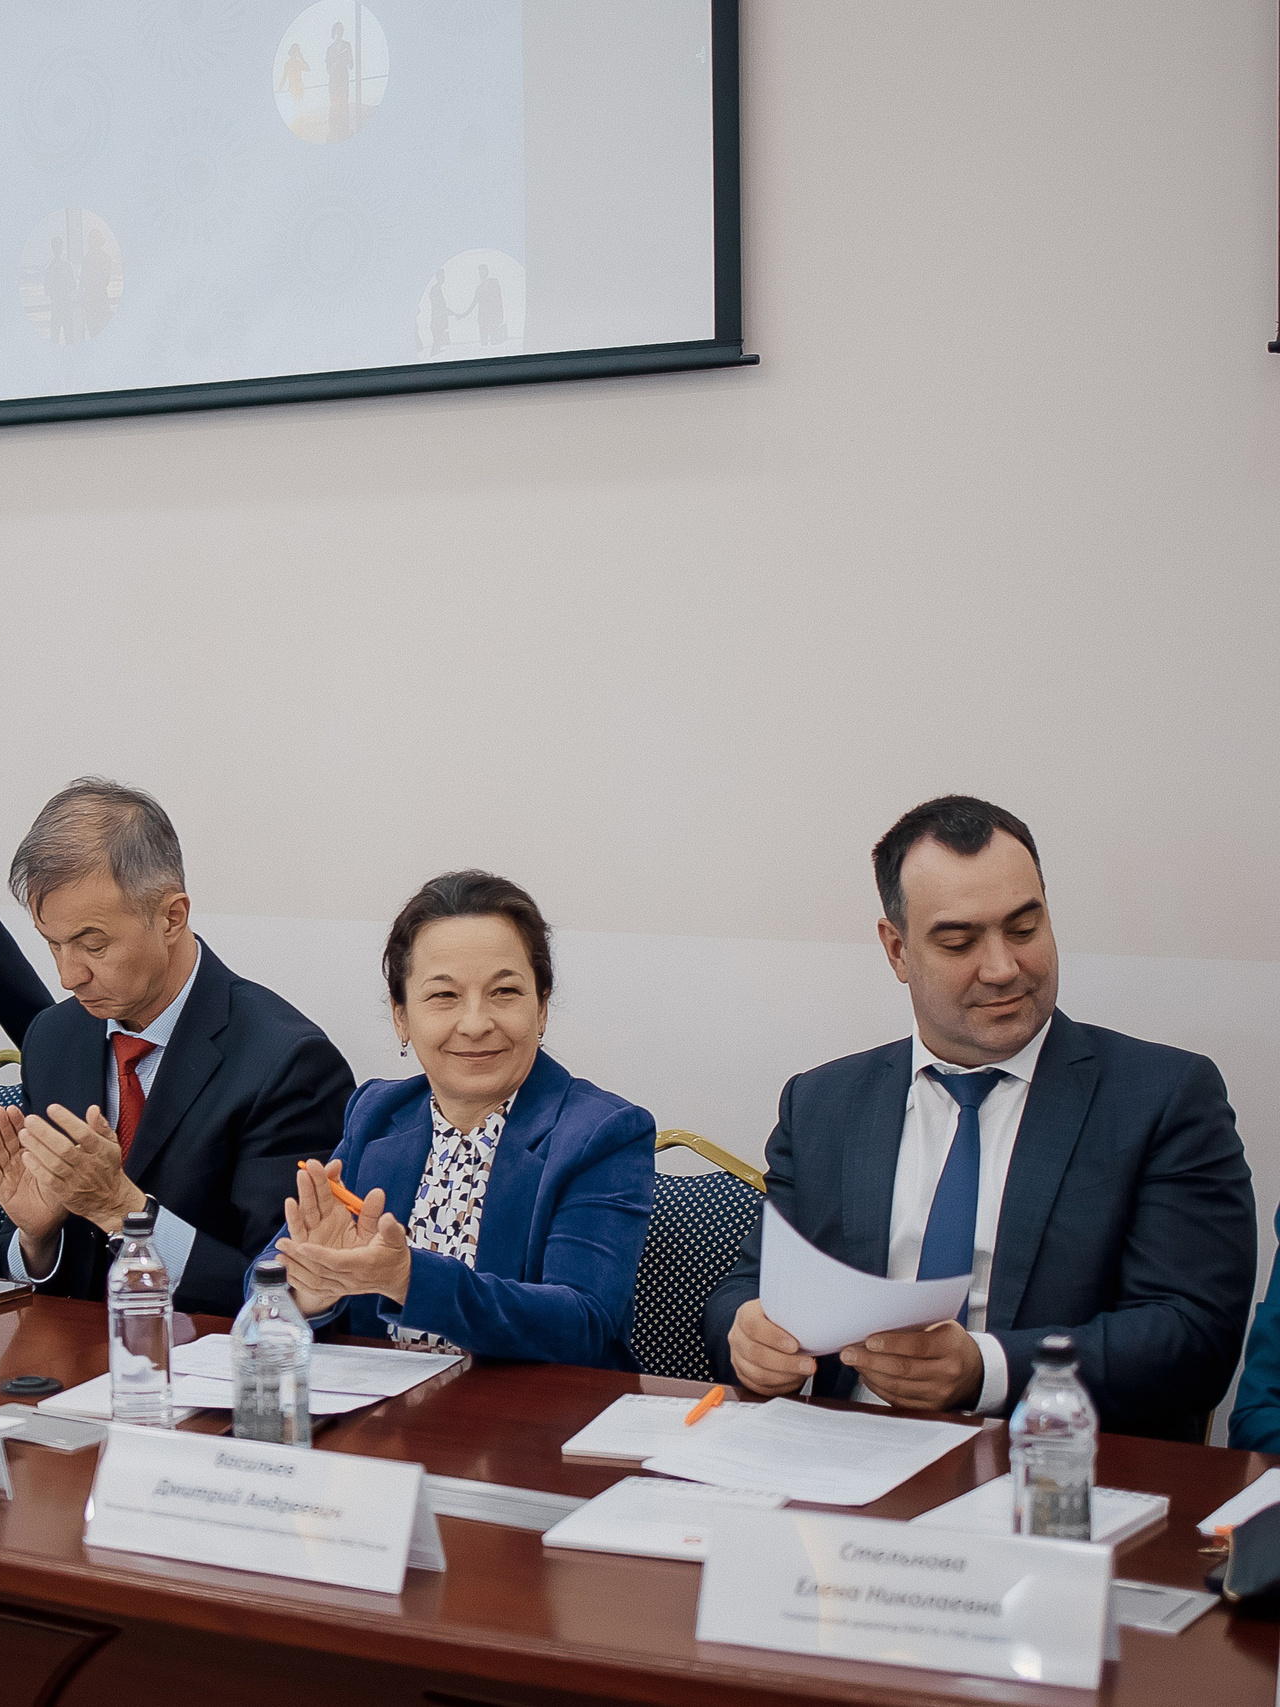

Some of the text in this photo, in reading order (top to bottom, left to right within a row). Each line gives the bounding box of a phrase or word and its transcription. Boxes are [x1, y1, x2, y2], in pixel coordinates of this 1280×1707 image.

[152, 1478, 343, 1519] Дмитрий Андреевич
[793, 1575, 1005, 1618] Елена Николаевна
